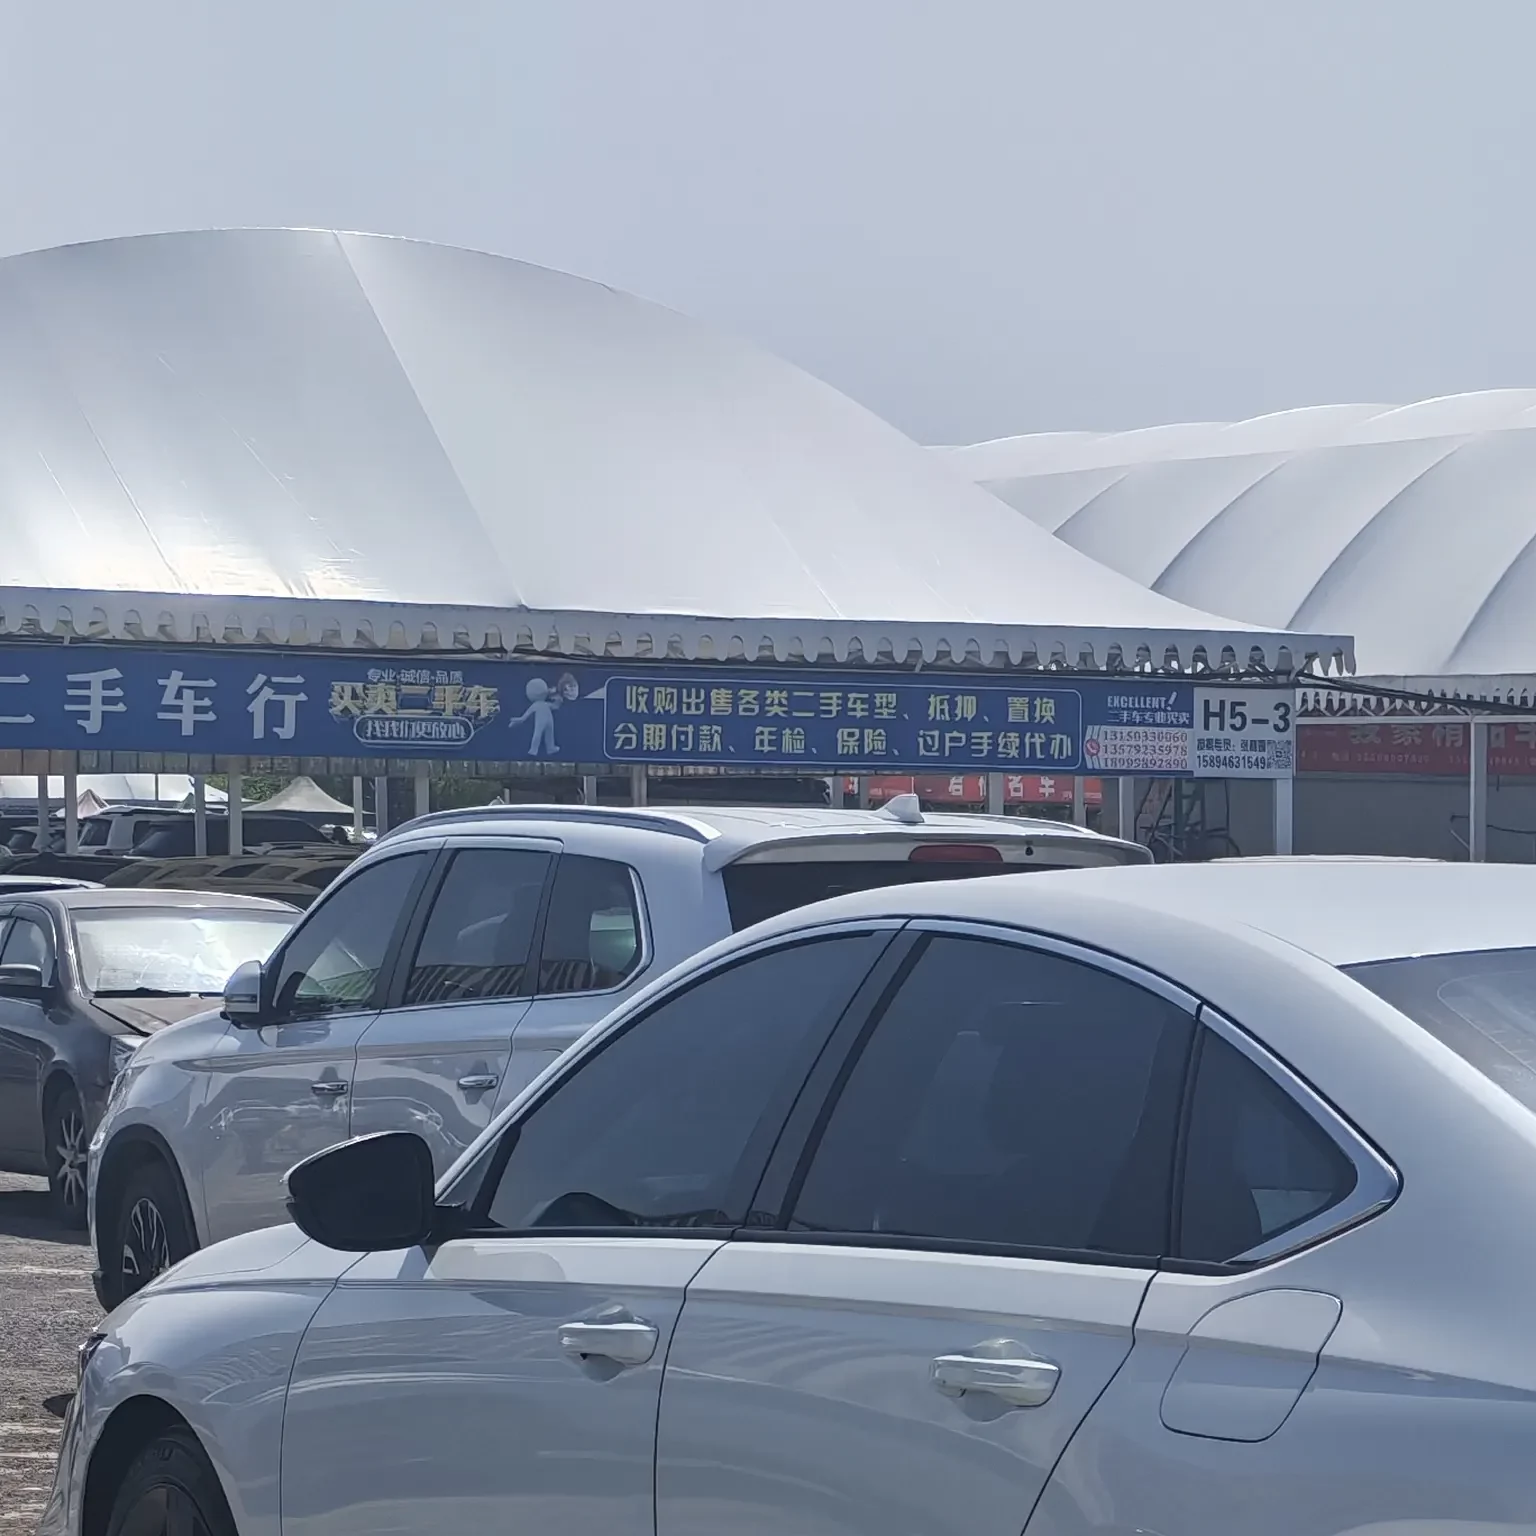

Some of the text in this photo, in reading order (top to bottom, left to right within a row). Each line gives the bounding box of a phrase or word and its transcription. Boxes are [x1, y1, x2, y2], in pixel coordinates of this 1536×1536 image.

[0, 667, 309, 740] 二手车行
[328, 681, 500, 718] 买卖二手车
[1107, 691, 1178, 712] EXCELLENT!
[1107, 711, 1190, 726] 二手车专业买卖
[1202, 699, 1291, 733] H5-3
[366, 720, 467, 740] 找我们更放心
